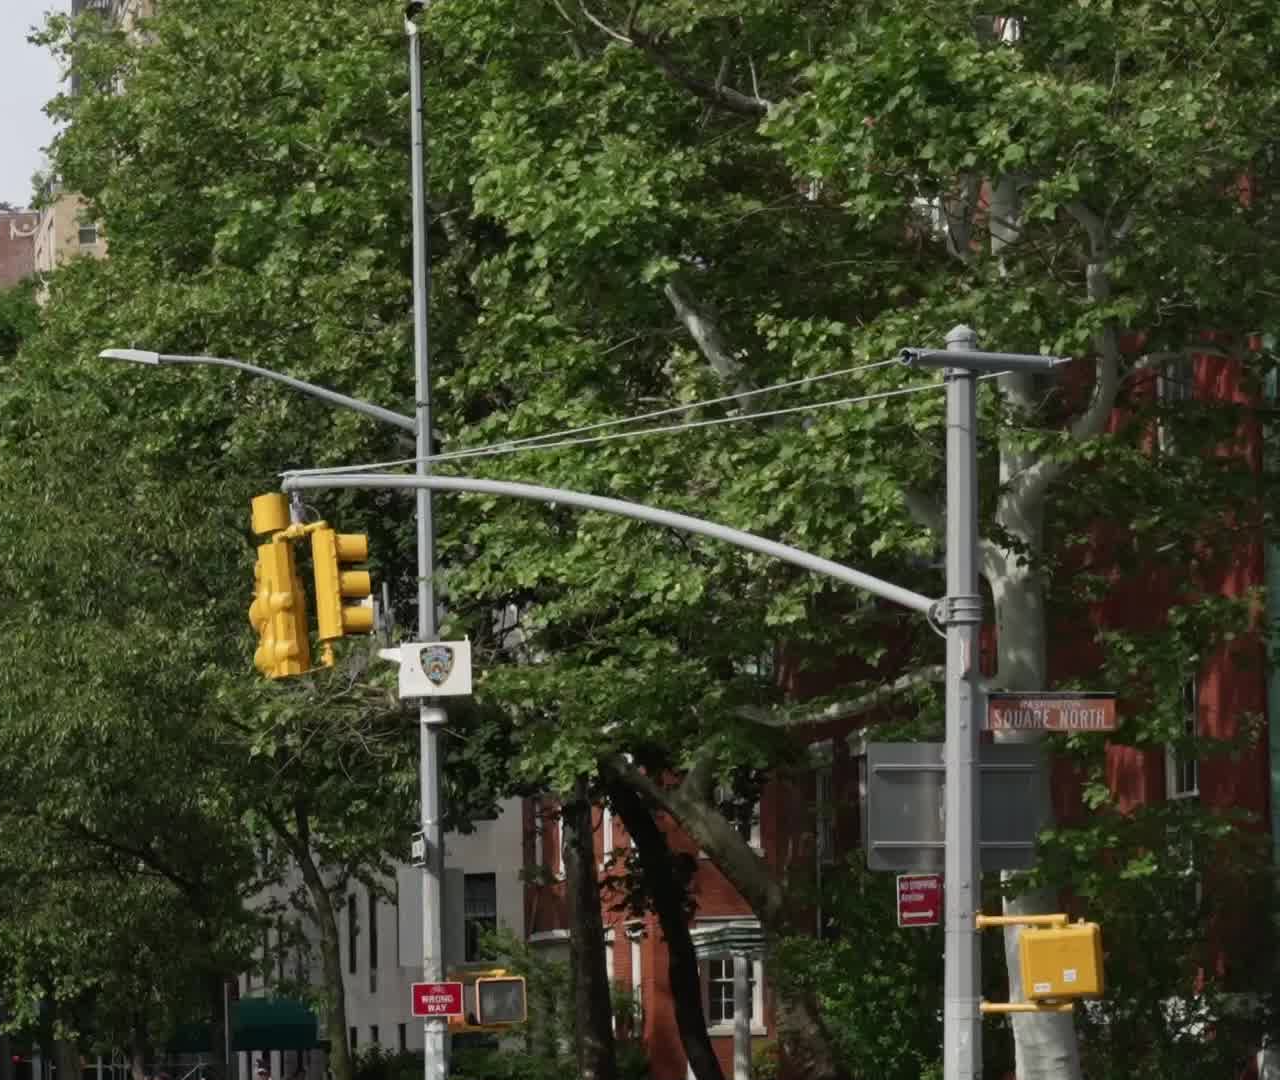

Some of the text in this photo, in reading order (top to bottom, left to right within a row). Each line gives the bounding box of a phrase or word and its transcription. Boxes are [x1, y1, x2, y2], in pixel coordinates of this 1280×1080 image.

[993, 707, 1105, 729] SQUARE NORTH
[421, 994, 454, 1004] WRONG
[427, 1003, 448, 1013] WAY
